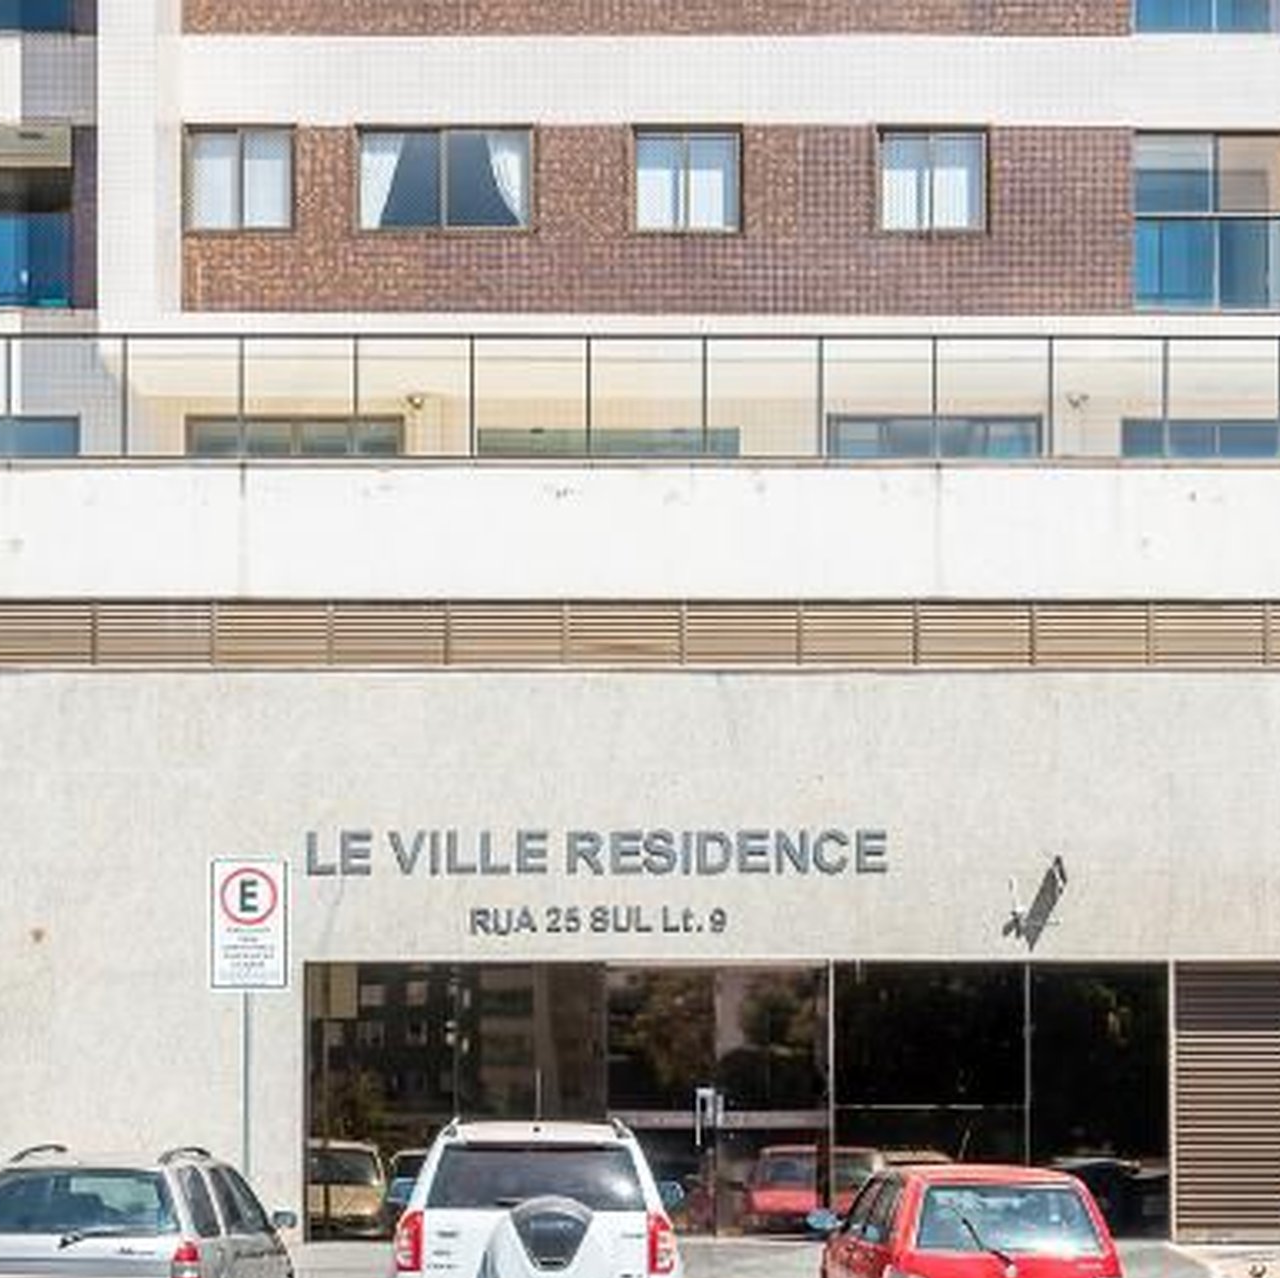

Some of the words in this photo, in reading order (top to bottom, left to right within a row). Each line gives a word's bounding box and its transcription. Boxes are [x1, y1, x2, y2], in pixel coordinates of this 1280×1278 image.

[305, 830, 373, 877] LE
[387, 830, 549, 877] VILLE
[566, 829, 889, 877] RESIDENCE
[238, 879, 259, 913] E
[469, 906, 539, 937] RUA
[545, 906, 583, 934] 25
[588, 905, 654, 934] SUL
[708, 907, 728, 934] 9
